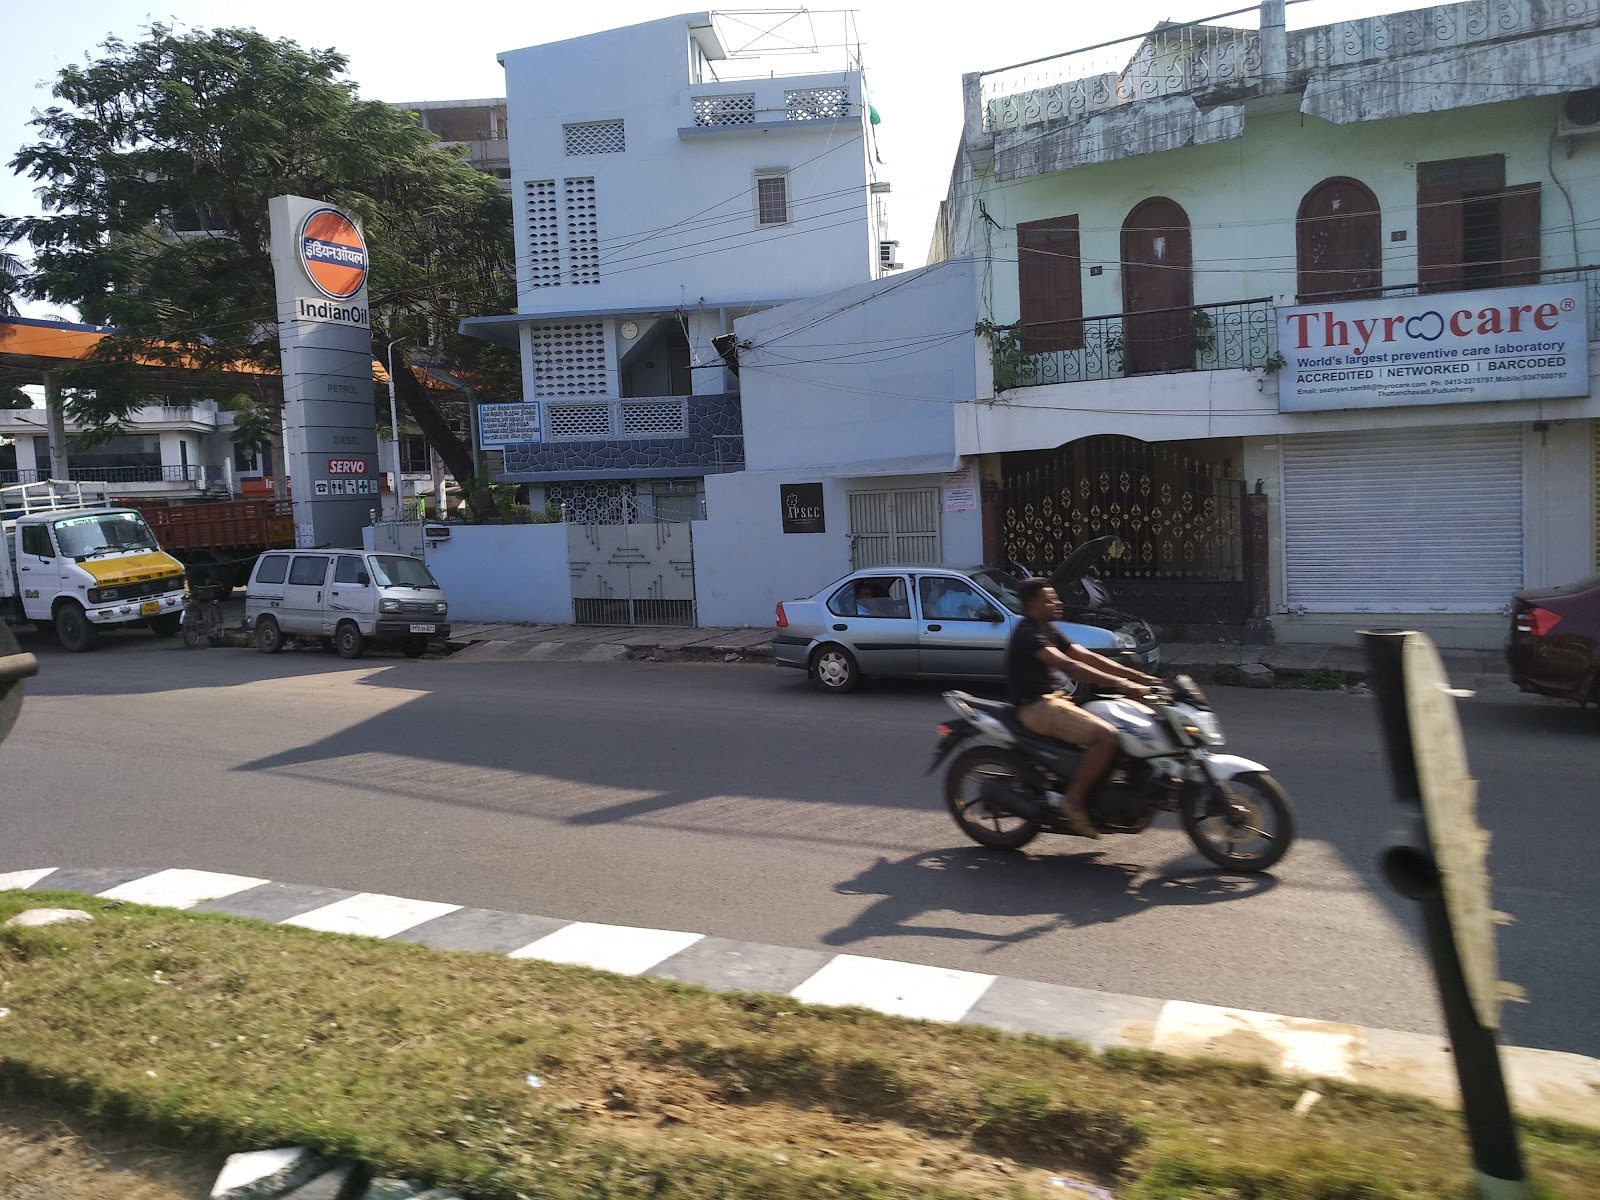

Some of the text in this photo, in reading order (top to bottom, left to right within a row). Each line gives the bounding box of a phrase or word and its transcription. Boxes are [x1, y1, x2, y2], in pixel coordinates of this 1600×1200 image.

[305, 240, 364, 265] इंडियनऑयल
[300, 299, 368, 325] IndianOil
[1297, 342, 1565, 368] World's largest preventive care laboratory
[1297, 356, 1566, 384] ACCREDITED NETWORKED BARCODED
[327, 384, 359, 394] PETROL
[333, 436, 360, 445] DIESEL
[329, 460, 365, 474] SERVO
